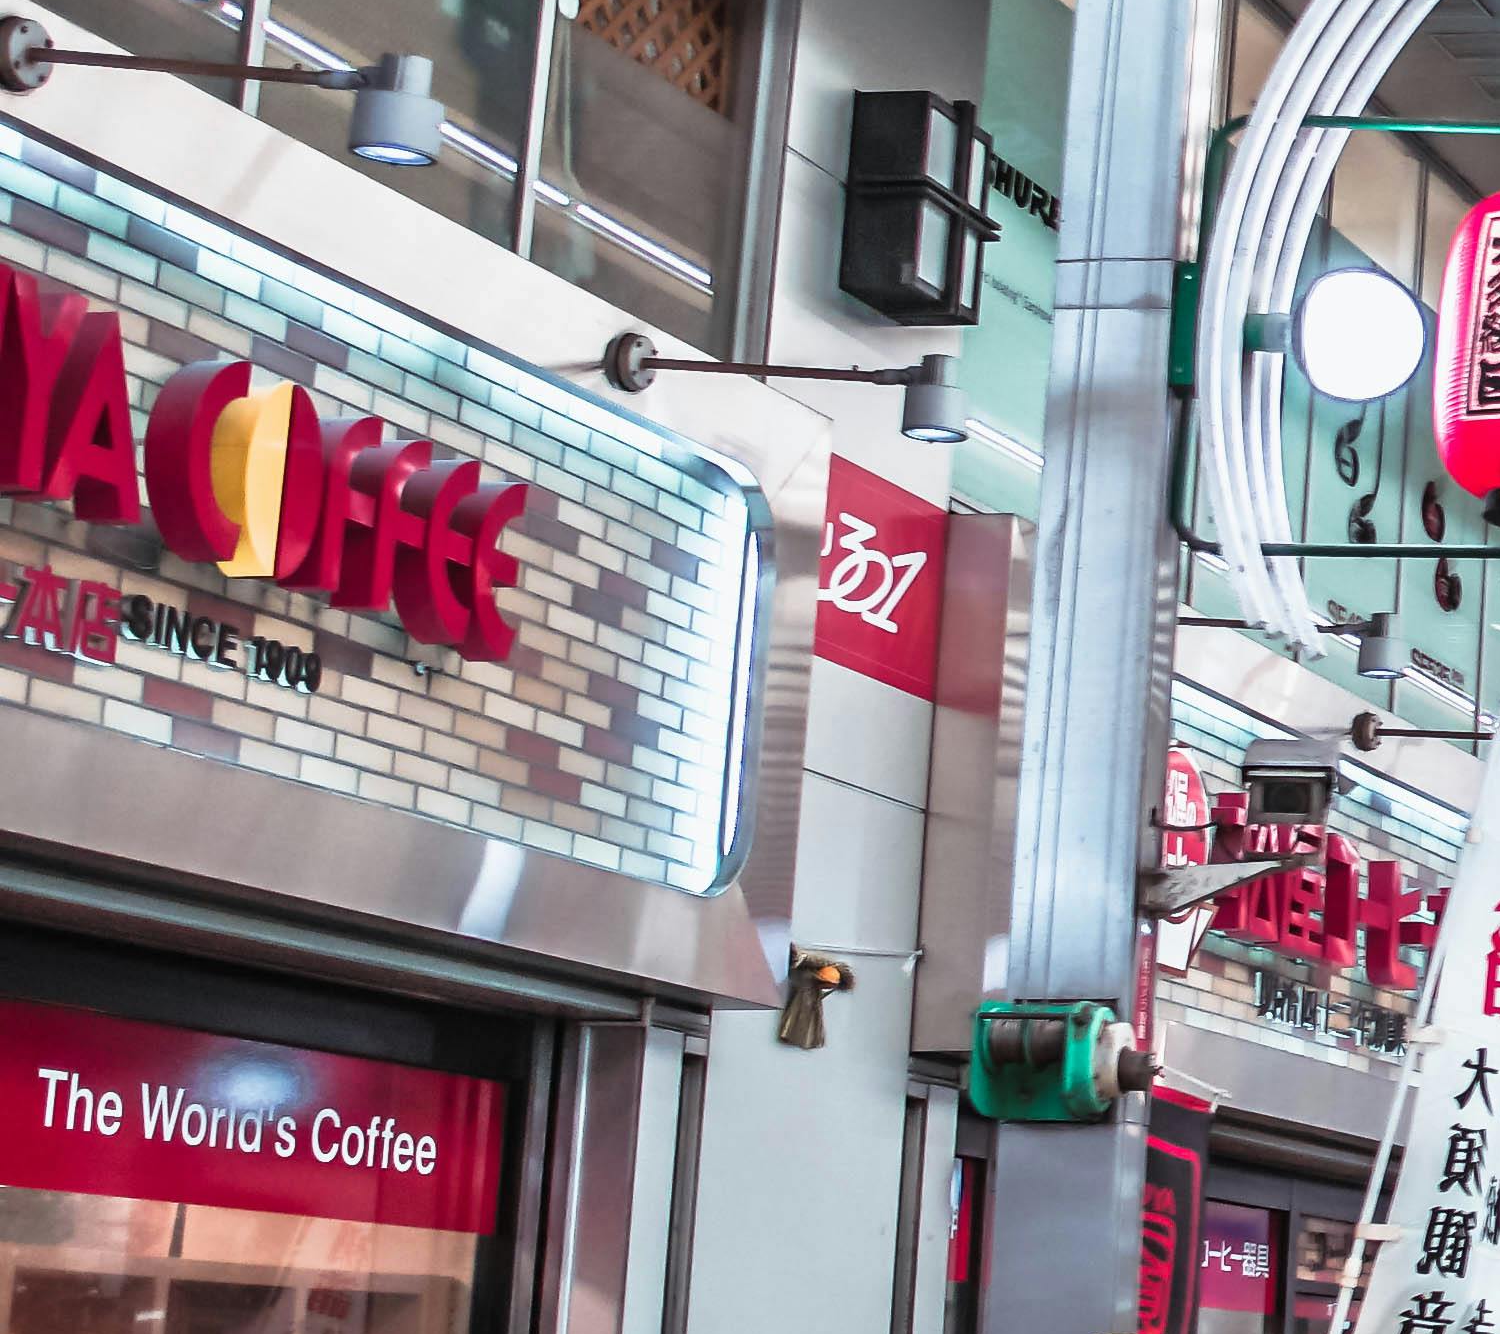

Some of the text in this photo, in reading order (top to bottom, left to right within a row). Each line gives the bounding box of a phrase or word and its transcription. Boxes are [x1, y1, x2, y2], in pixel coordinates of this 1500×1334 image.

[144, 359, 527, 663] COFFEE
[121, 593, 240, 671] SINCE
[247, 634, 323, 694] 1909
[37, 1067, 438, 1176] The World's Coffee
